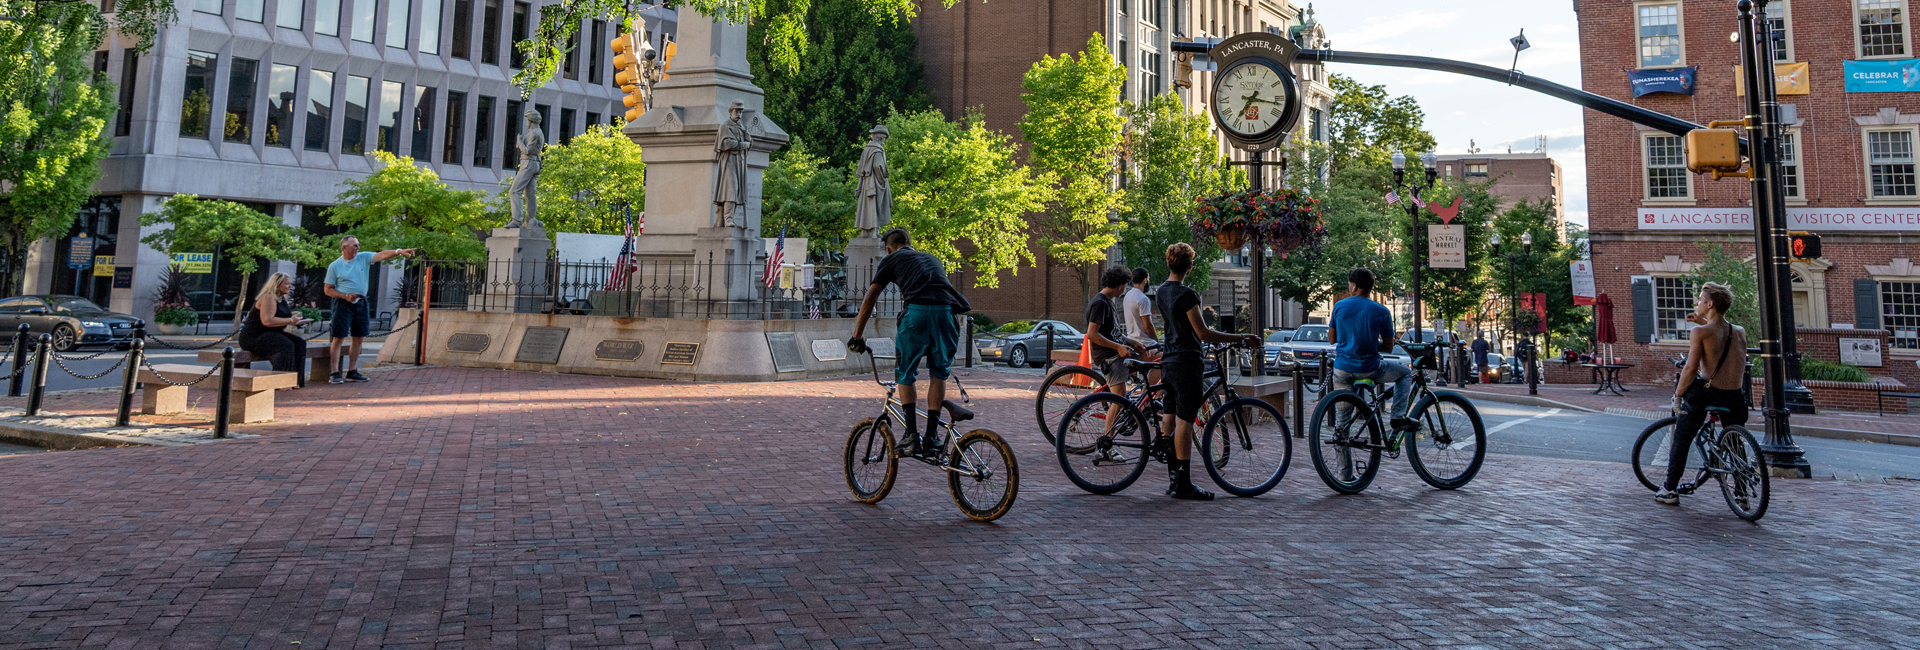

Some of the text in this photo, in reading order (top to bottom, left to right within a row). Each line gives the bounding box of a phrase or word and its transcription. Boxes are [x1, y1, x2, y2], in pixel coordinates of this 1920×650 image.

[1221, 40, 1285, 57] LANCASTER, PA
[1233, 70, 1243, 81] XI
[1224, 82, 1233, 90] X
[1662, 214, 1750, 224] LANCASTER
[1793, 214, 1856, 224] VISITOR
[1430, 236, 1462, 244] CENTRAL
[187, 254, 212, 262] LEASE
